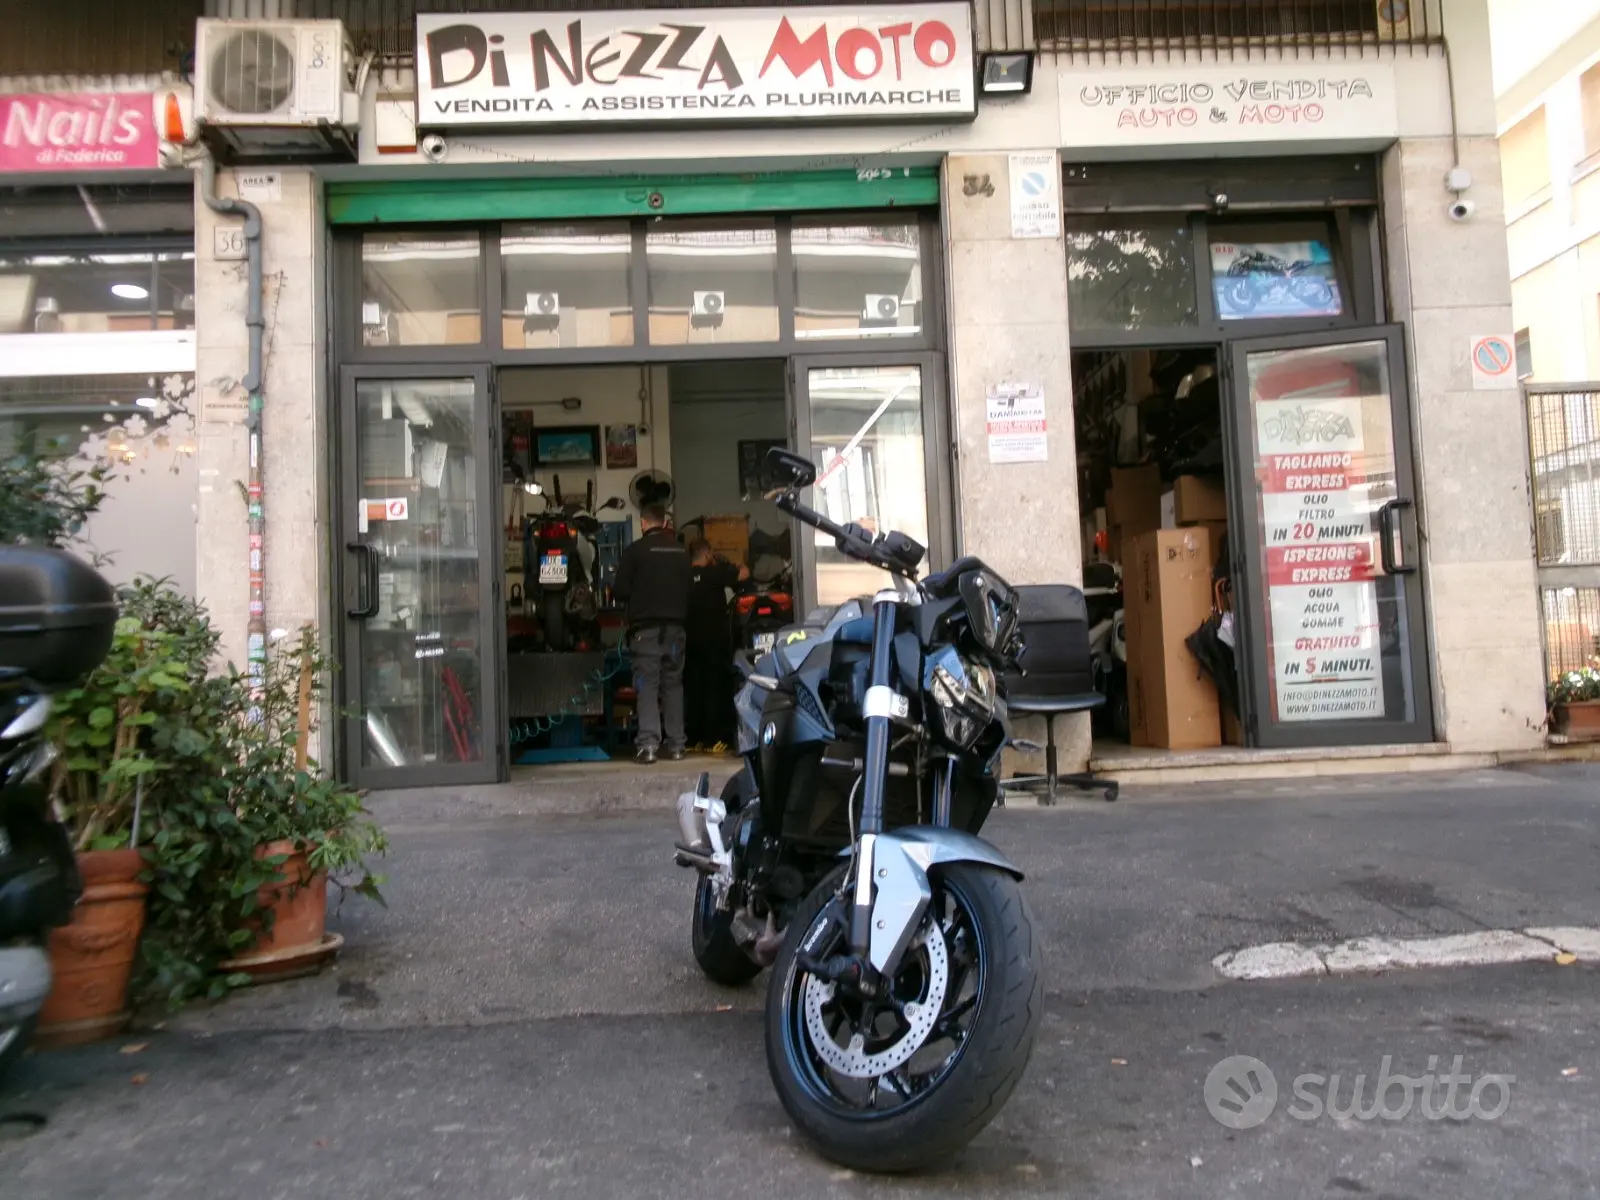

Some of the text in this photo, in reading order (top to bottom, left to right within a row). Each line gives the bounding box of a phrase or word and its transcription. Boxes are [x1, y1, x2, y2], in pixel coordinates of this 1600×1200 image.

[758, 15, 958, 88] MOTO
[1080, 77, 1373, 106] UFFICIO VENDITA
[435, 96, 554, 114] VENDITA
[583, 92, 755, 111] ASSISTENZA
[767, 89, 962, 106] PLURIMARCHE
[3, 96, 144, 147] Nails
[1117, 102, 1324, 128] AUTO & MOTO
[36, 149, 125, 163] di Federica
[962, 172, 995, 198] 34
[1274, 453, 1352, 470] TAGLIANDO
[1285, 474, 1345, 489] EXPRESS
[1303, 494, 1328, 505] OLIO
[1298, 508, 1335, 520] FILTRO
[1273, 523, 1364, 541] IN 20 MINUTI
[1283, 547, 1356, 563] ISPEZIONE
[1292, 567, 1351, 582] EXPRESS
[1308, 588, 1333, 598] OLIO
[1304, 602, 1340, 614] ACQUA
[1302, 617, 1344, 629] GOMME
[1295, 635, 1360, 651] GRATUITO
[1285, 663, 1300, 675] IN
[1305, 657, 1316, 674] 5
